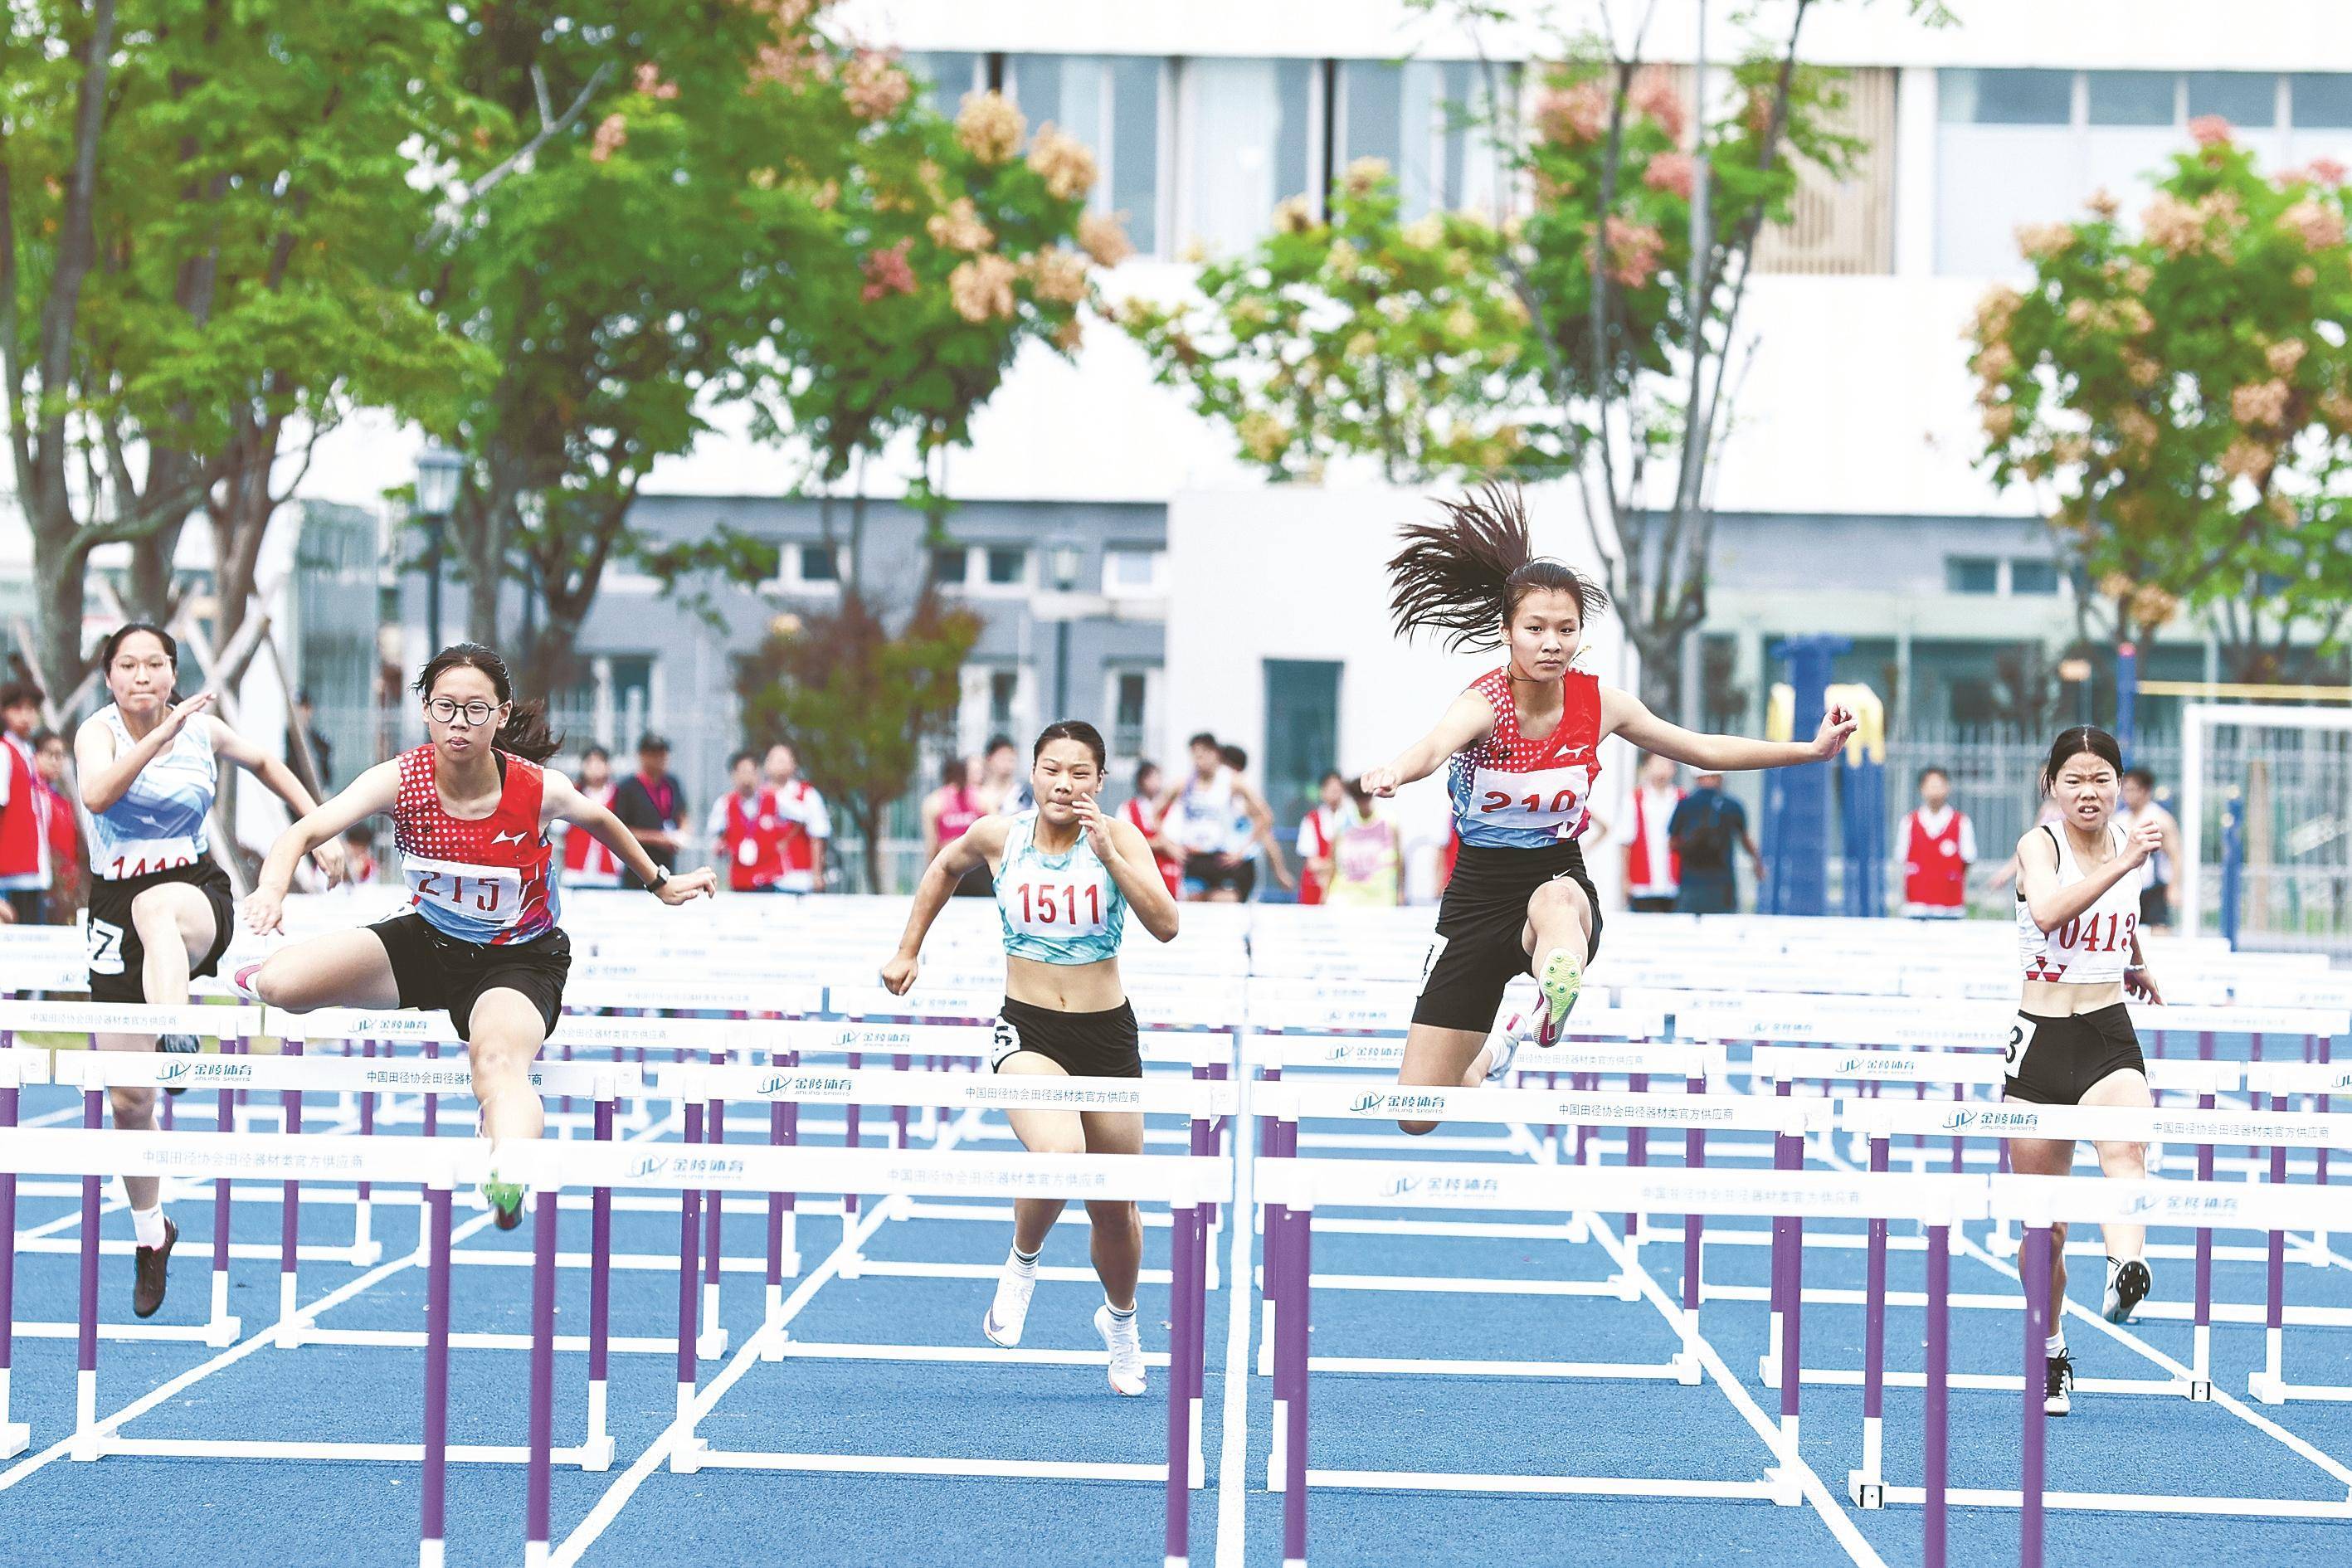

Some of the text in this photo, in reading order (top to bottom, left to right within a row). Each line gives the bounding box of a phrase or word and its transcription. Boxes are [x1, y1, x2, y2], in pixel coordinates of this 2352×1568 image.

[1481, 790, 1576, 813] 210
[418, 871, 499, 911] 215
[1017, 883, 1100, 924] 1511
[2059, 913, 2136, 952] 0413
[93, 929, 114, 961] 7
[2005, 1025, 2023, 1064] 3
[194, 1064, 252, 1076] 金陵体育
[795, 1078, 853, 1091] 金陵体育
[966, 1086, 1140, 1103] 中国田径协会田径器材类官方供应商
[1387, 1095, 1446, 1108] 金陵体育
[1559, 1103, 1734, 1121] 中国田径协会田径器材类官方供应商
[1980, 1113, 2038, 1126] 金陵体育
[2152, 1122, 2330, 1139] 中国田径协会田径器材类官方供应商
